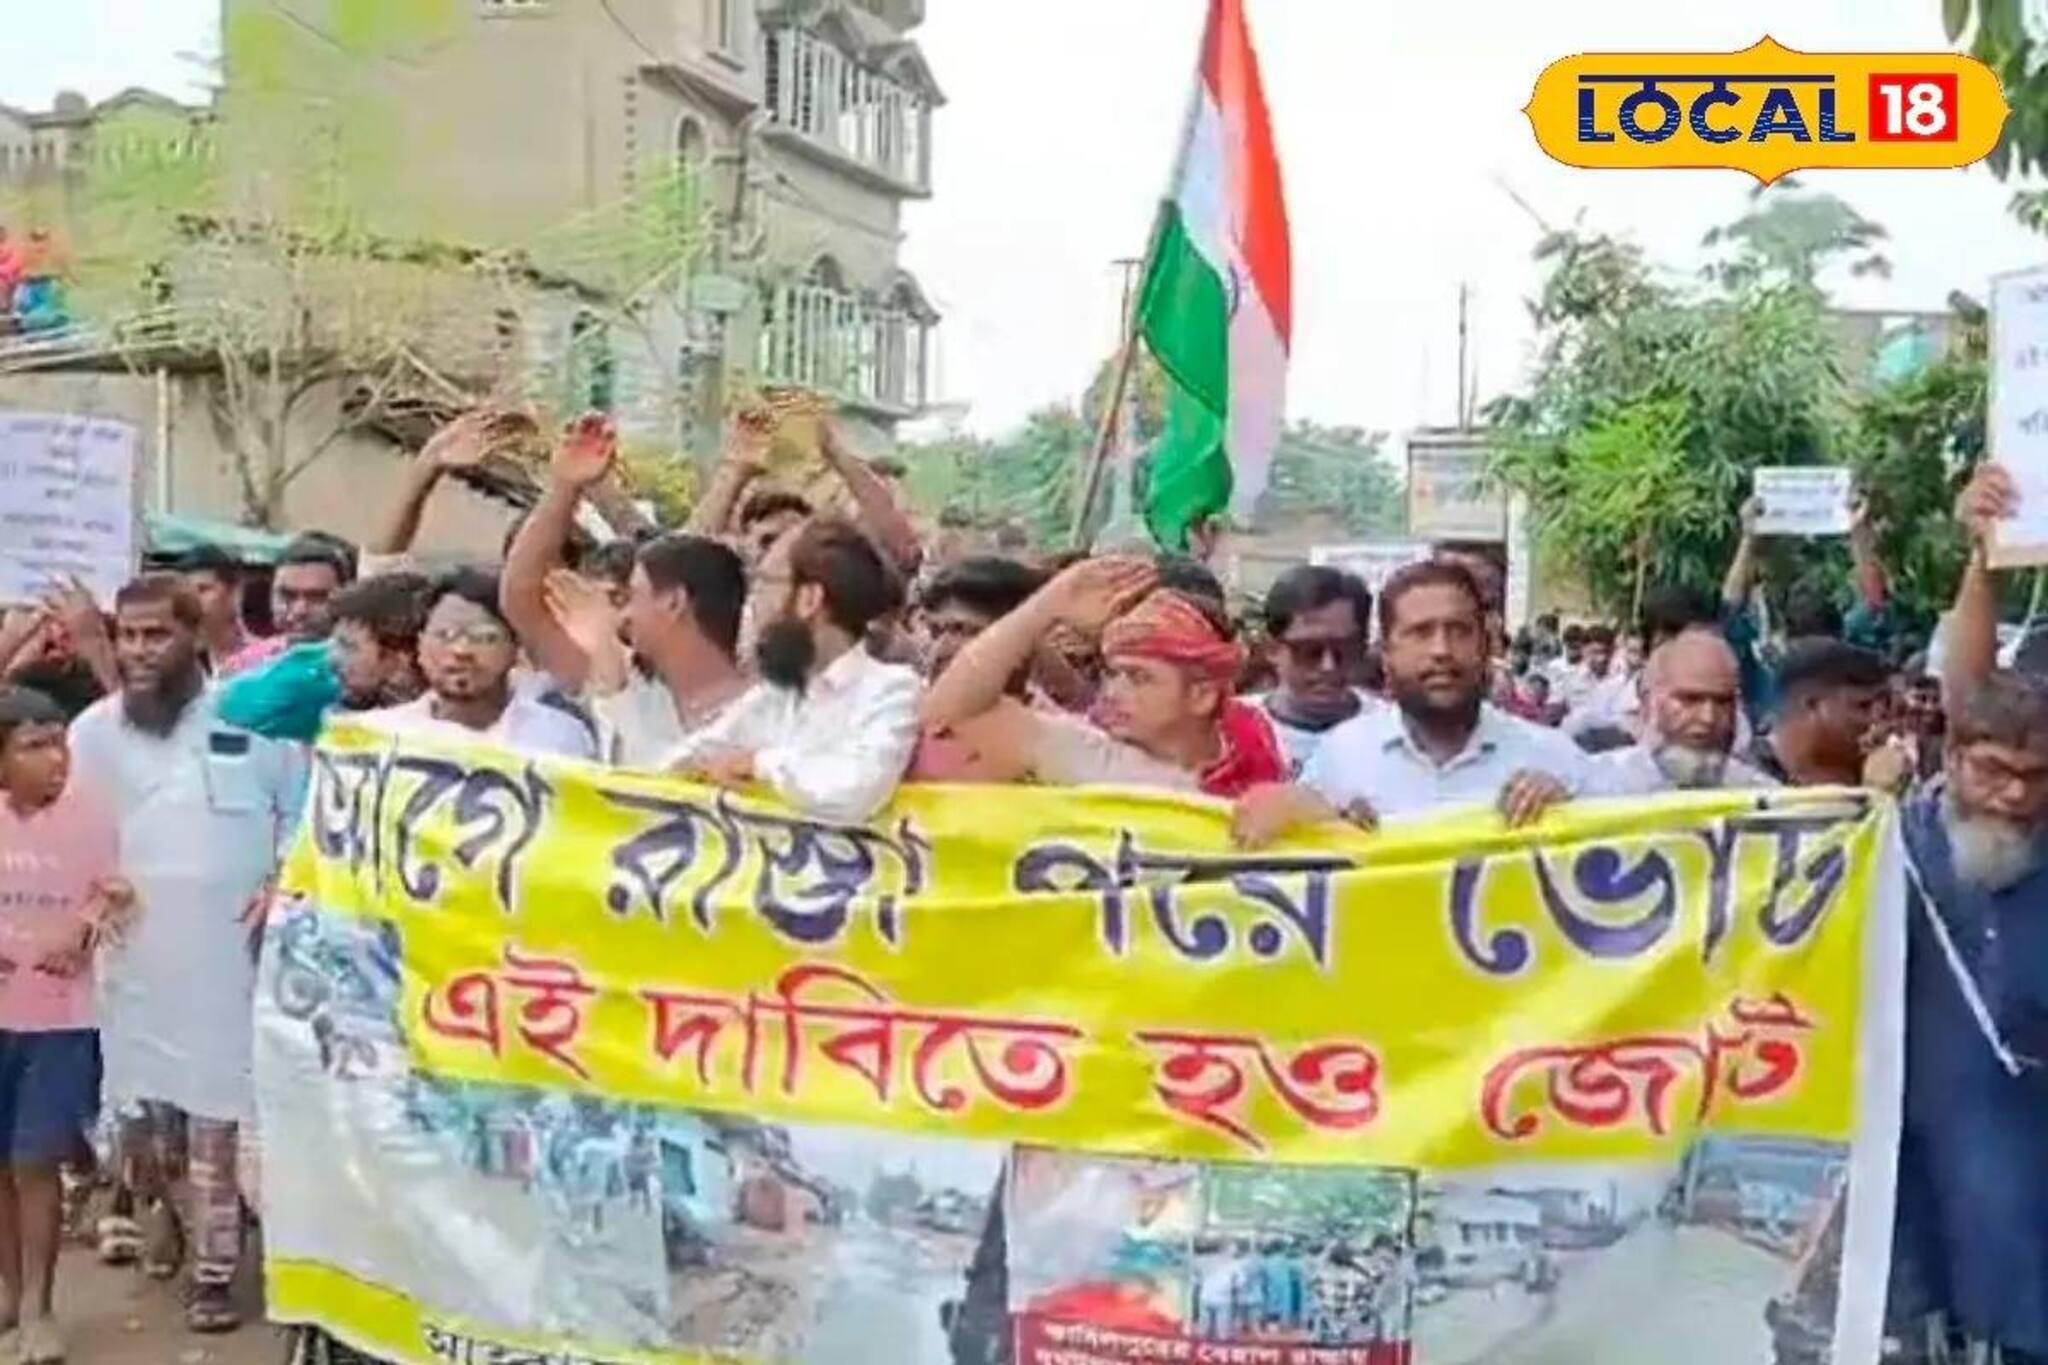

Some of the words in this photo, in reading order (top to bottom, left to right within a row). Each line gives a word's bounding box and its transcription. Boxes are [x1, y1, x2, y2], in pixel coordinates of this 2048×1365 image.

[314, 738, 556, 912] আগে
[594, 788, 932, 942] রাস্তা
[1014, 828, 1356, 966] পরে
[1449, 795, 1868, 974] ভোট
[424, 942, 596, 1080] এই
[641, 964, 1084, 1110] দাবিতে
[1134, 1030, 1380, 1151] হও
[1482, 991, 1816, 1140] জোট
